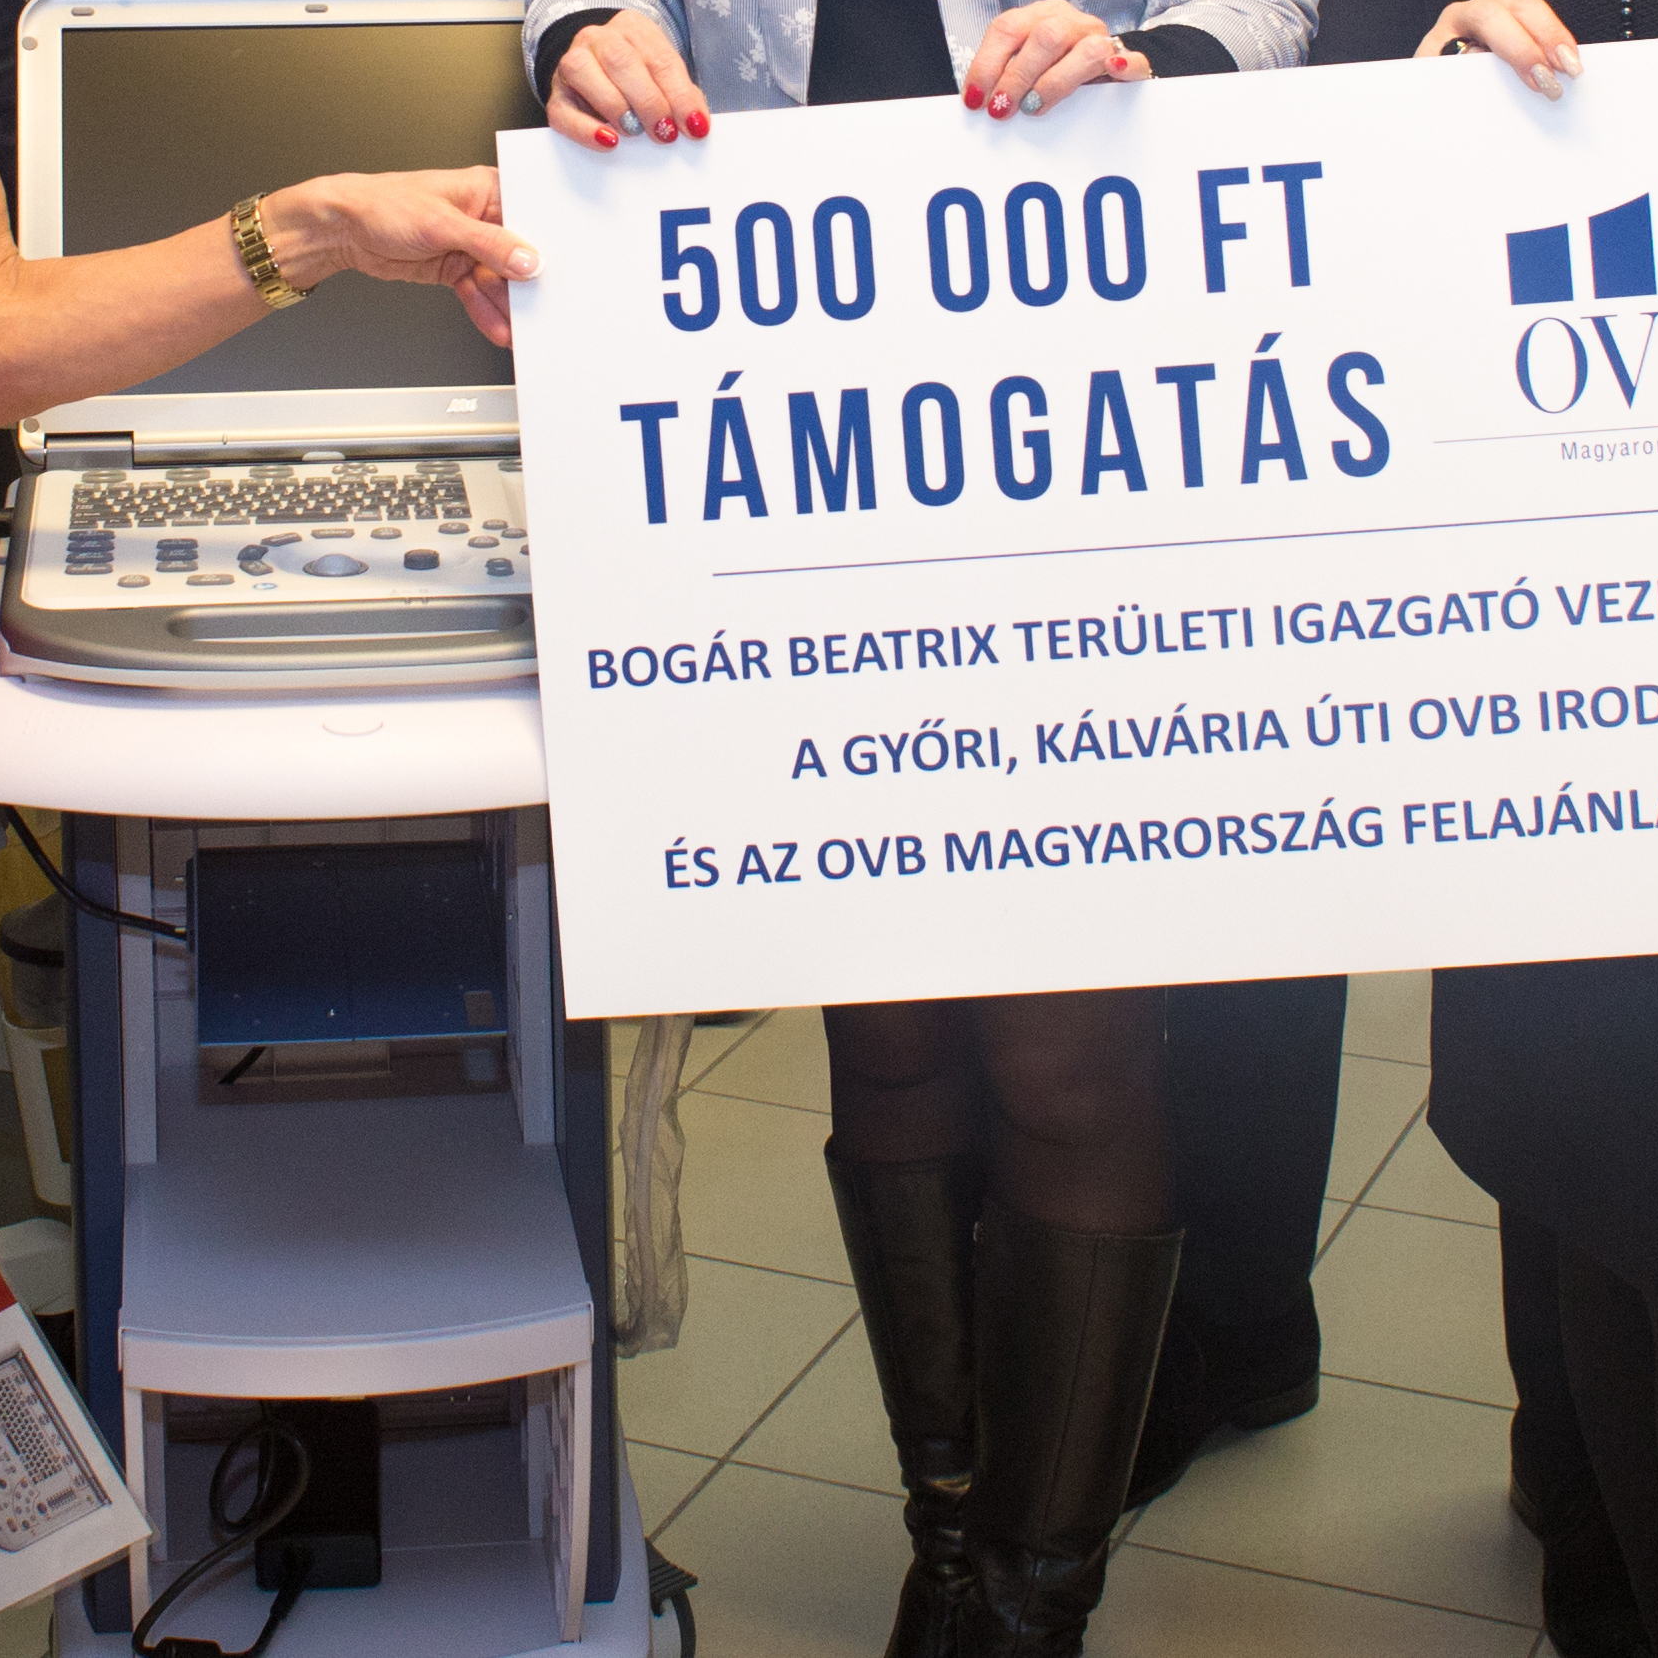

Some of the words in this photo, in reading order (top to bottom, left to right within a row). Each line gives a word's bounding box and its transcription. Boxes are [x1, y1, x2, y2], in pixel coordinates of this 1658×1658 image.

[660, 196, 876, 332] 500
[927, 176, 1147, 312] 000
[1198, 161, 1323, 293] FT
[620, 331, 1390, 524] TÁMOGATÁS
[588, 630, 771, 689] BOGÁR
[789, 625, 999, 676] BEATRIX
[1013, 604, 1253, 661] TERÜLETI
[1274, 577, 1539, 645] IGAZGATÓ
[792, 739, 827, 779] A
[843, 719, 1017, 776] GYŐRI,
[1037, 703, 1289, 764] KÁLVÁRIA
[1307, 694, 1390, 747] ÚTI
[1410, 695, 1520, 740] OVB
[665, 837, 719, 889] ÉS
[737, 843, 801, 885] AZ
[818, 836, 926, 880] OVB
[945, 798, 1383, 873] MAGYARORSZÁG
